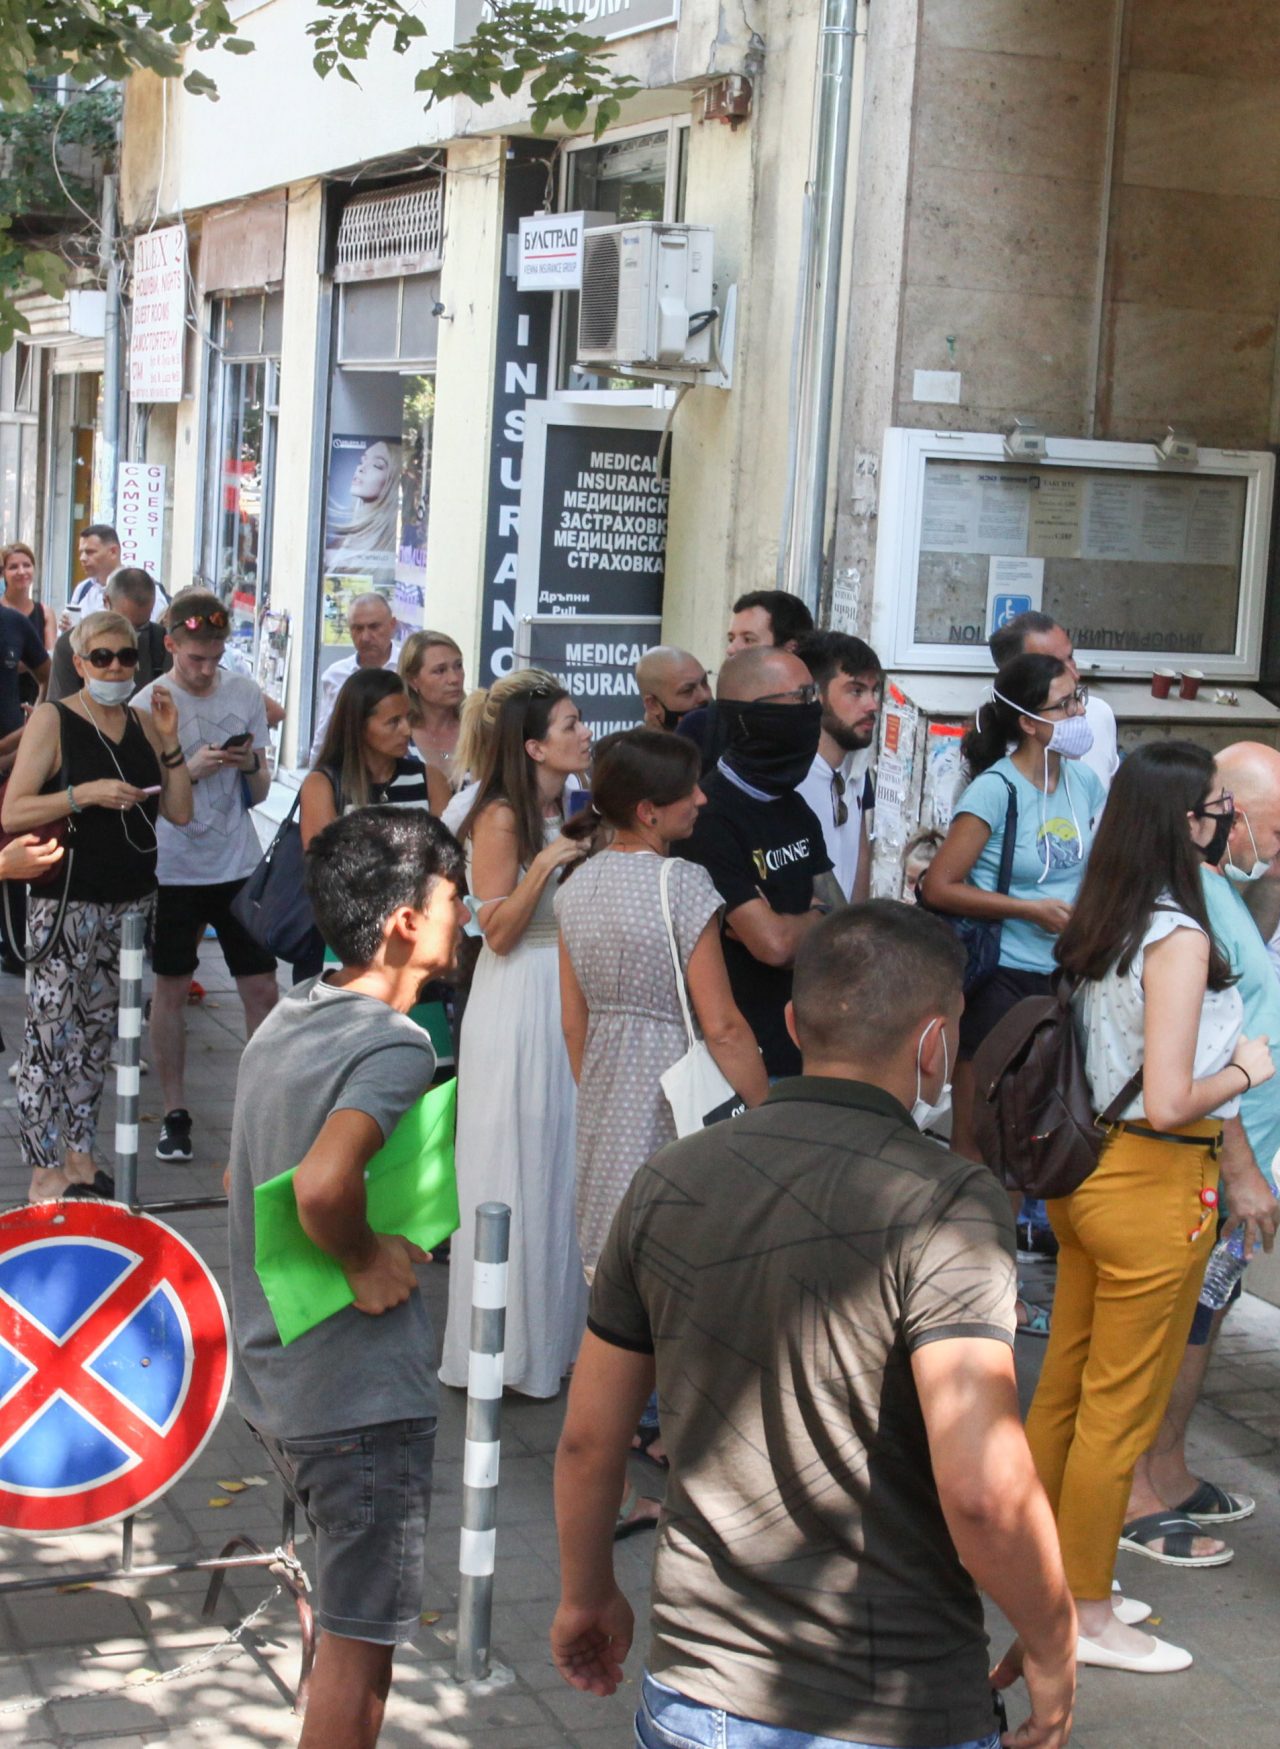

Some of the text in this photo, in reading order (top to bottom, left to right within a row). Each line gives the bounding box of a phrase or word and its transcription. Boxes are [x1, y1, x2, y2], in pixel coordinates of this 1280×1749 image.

[577, 472, 671, 495] INSURANCE
[122, 466, 140, 562] САМОСТОЯ
[567, 551, 664, 573] СТРАХОВКА
[539, 590, 590, 603] Дръпни
[552, 605, 576, 616] Pull
